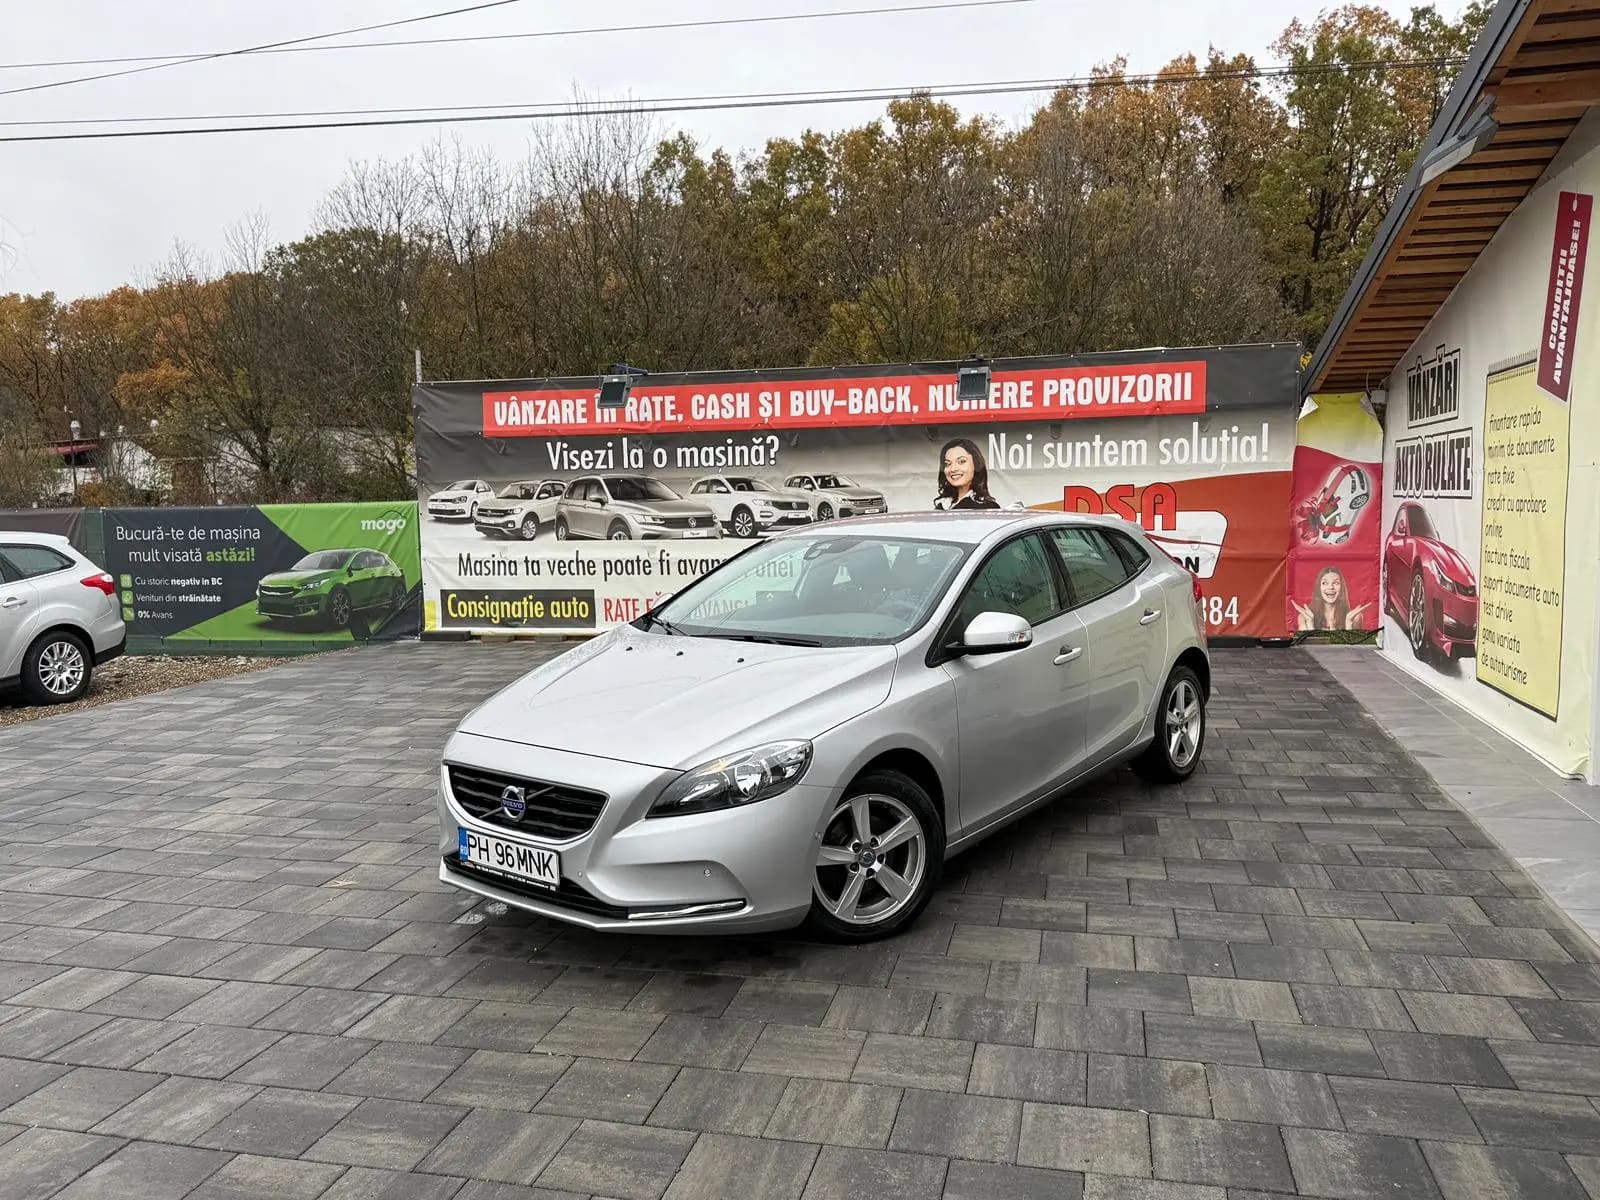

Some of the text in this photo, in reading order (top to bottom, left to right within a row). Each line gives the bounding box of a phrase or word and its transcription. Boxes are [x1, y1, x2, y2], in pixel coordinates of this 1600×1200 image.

[1553, 219, 1582, 385] AVANTAJOASE!
[494, 396, 588, 426] VÂNZARE
[625, 395, 683, 423] RATE,
[691, 392, 749, 420] CASH
[758, 391, 781, 424] ȘI
[789, 385, 919, 417] BUY-BACK,
[1042, 372, 1192, 408] PROVIZORII
[1408, 353, 1458, 422] VÂNZĂRI
[1518, 405, 1541, 432] rapida
[546, 434, 780, 475] Visezi la o mașină?
[988, 421, 1270, 472] Noi suntem soluția!
[1507, 437, 1515, 457] de
[1516, 434, 1555, 456] documente
[1395, 436, 1471, 492] AUTO RULATE
[1487, 465, 1515, 485] rate fixe
[1063, 482, 1177, 531] DSA
[1486, 492, 1547, 518] credit cu aprobare
[116, 525, 261, 543] Bucură-te de mașina
[360, 518, 407, 535] mogo
[1485, 519, 1503, 538] online
[128, 547, 256, 562] mult visată astăzi!
[524, 555, 541, 576] ta
[547, 550, 596, 576] veche
[603, 554, 652, 582] poate
[658, 549, 671, 576] fi
[1484, 544, 1530, 570] factura fiscala
[134, 576, 146, 585] Cu
[147, 576, 170, 586] istoric
[170, 576, 200, 588] negativ
[210, 576, 223, 586] BC
[1483, 575, 1560, 607] suport documente auto
[136, 593, 164, 603] Venituri
[164, 593, 177, 603] din
[447, 593, 590, 625] Consignație auto
[603, 597, 641, 622] RATE
[1483, 598, 1513, 622] test drive
[137, 610, 174, 619] 0% Avans
[1482, 627, 1521, 654] gama variata
[1481, 648, 1528, 685] de autoturisme
